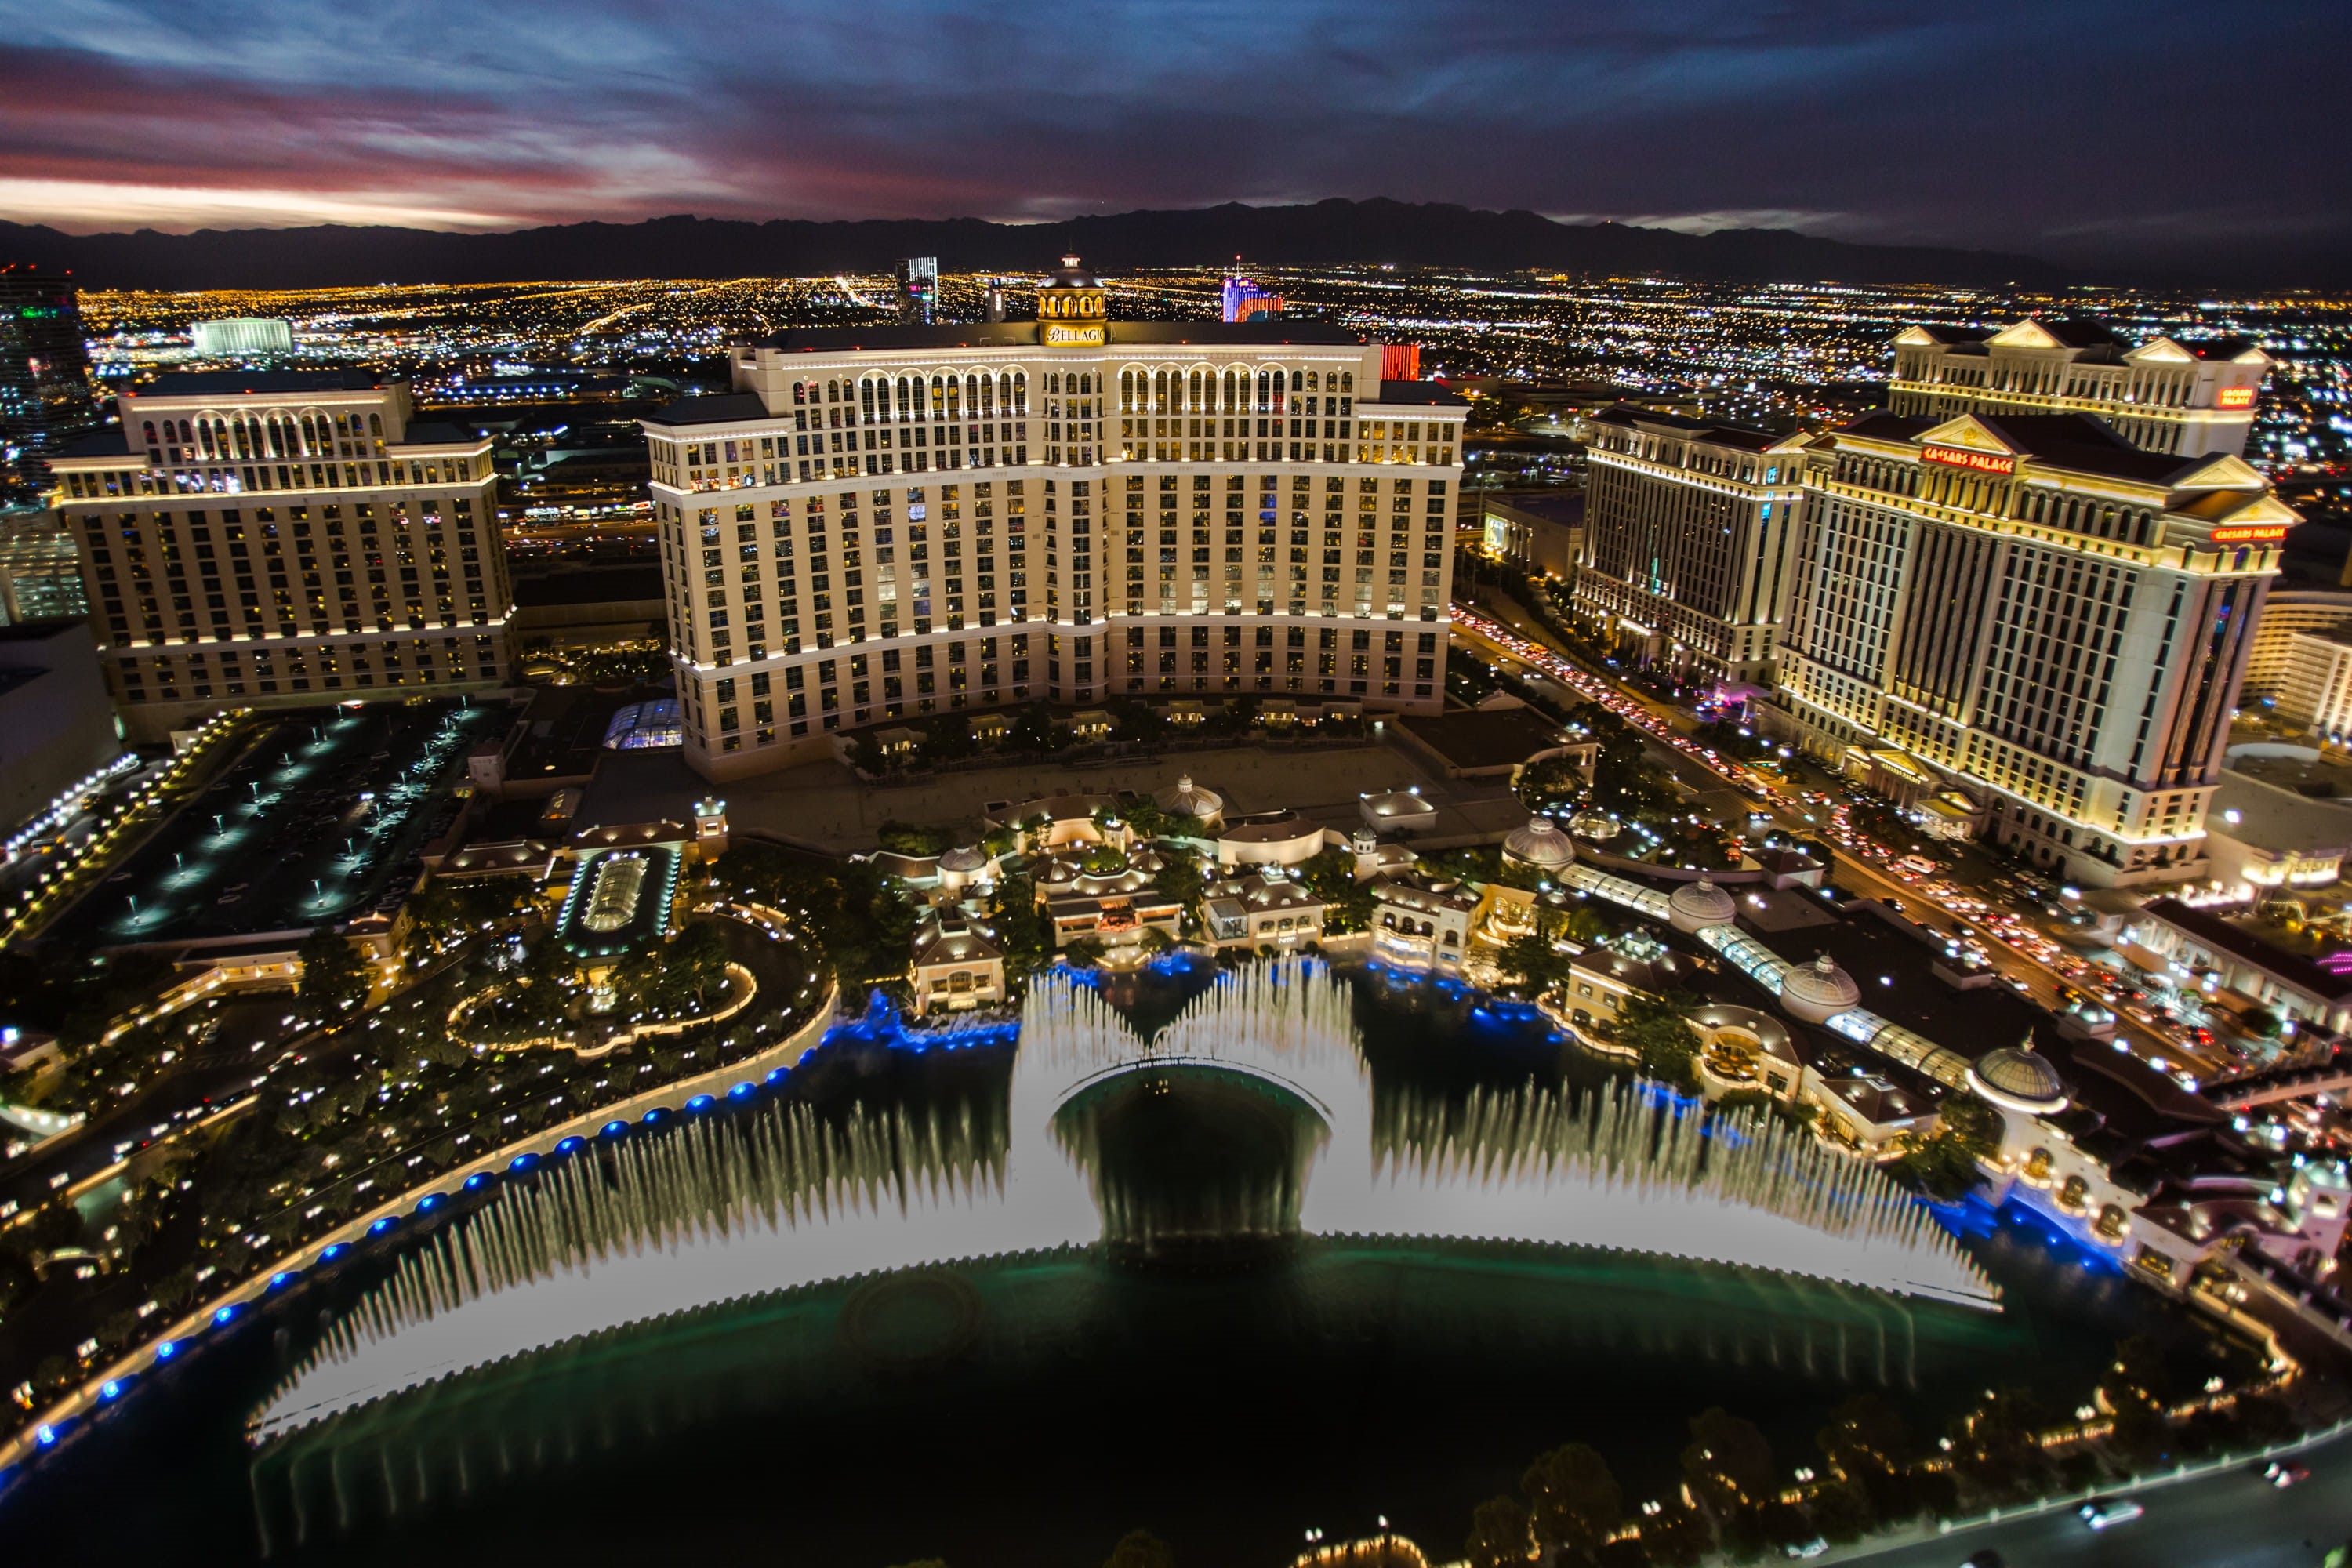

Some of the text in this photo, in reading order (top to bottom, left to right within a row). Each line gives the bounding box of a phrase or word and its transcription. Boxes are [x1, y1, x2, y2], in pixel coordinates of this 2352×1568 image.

[1924, 448, 2013, 473] CAESARS PALACE
[2215, 528, 2285, 539] CAESARS PALACE
